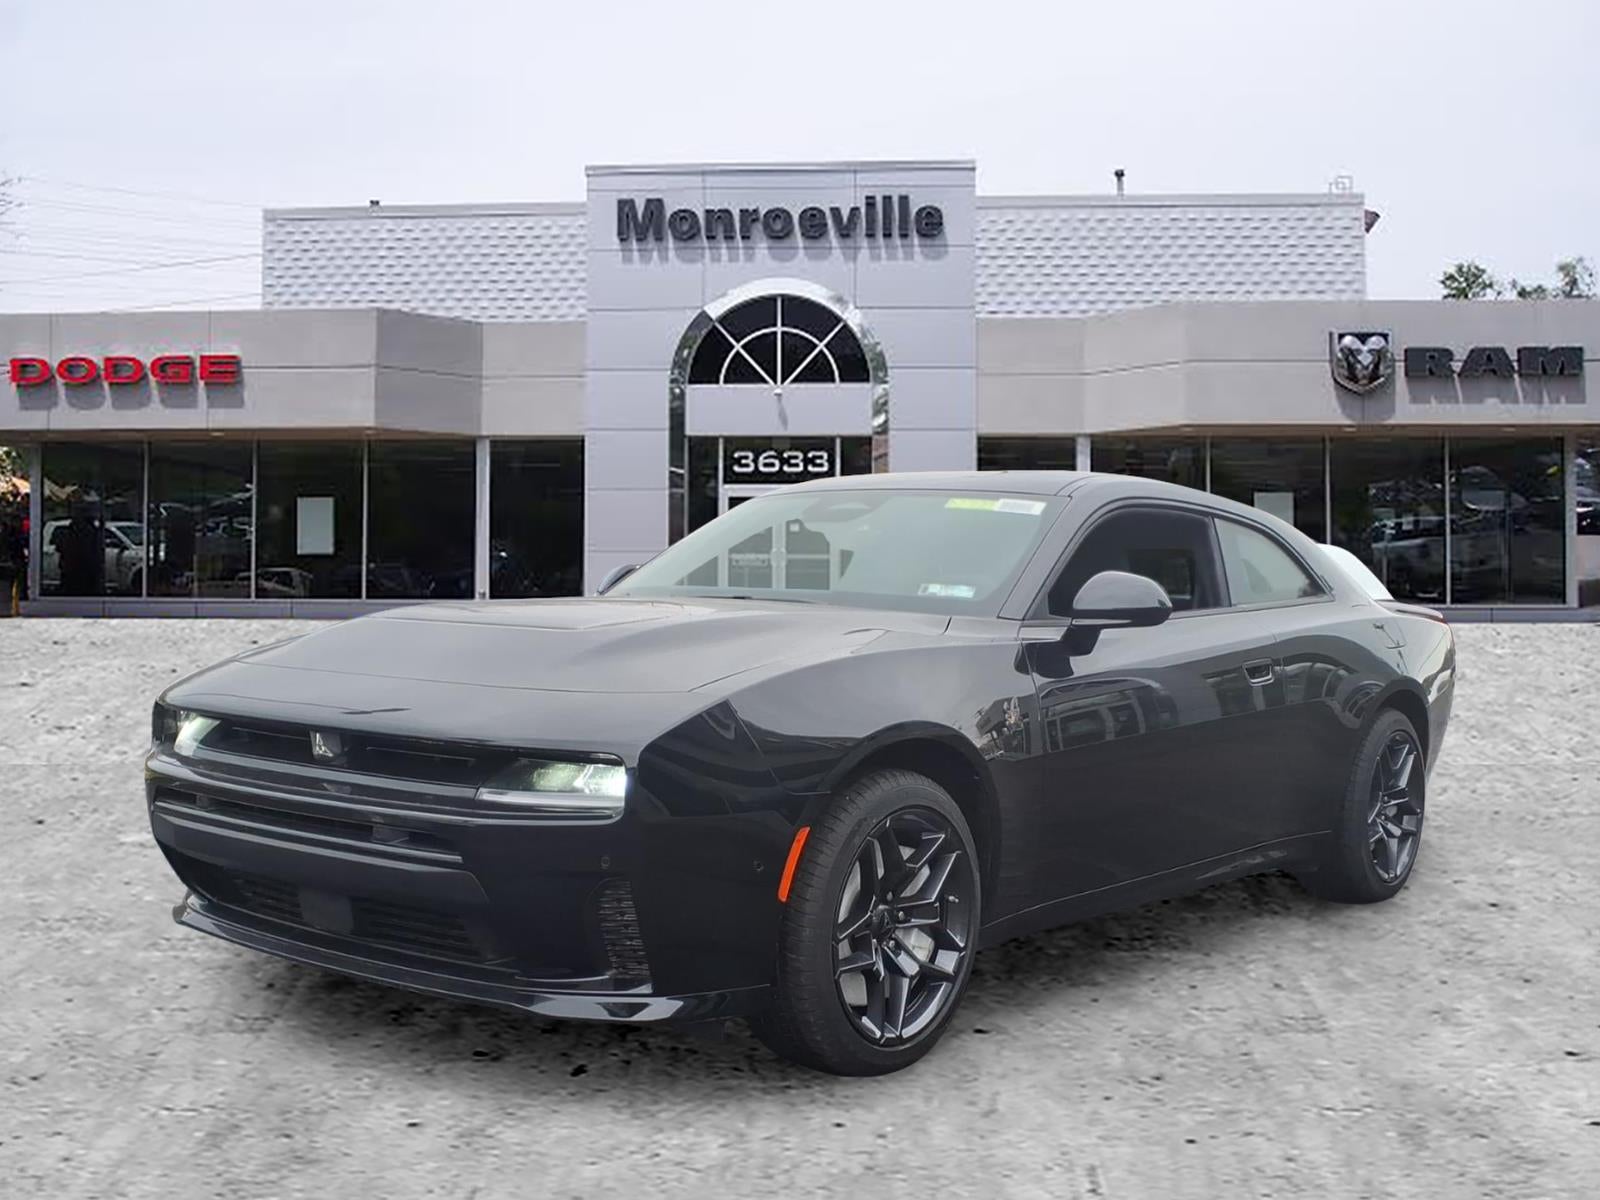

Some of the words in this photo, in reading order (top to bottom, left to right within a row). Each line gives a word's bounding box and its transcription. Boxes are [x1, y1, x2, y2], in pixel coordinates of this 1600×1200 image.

[617, 194, 944, 241] Monroeville
[9, 355, 241, 383] DODGE
[1405, 346, 1583, 376] RAM
[732, 450, 829, 473] 3633
